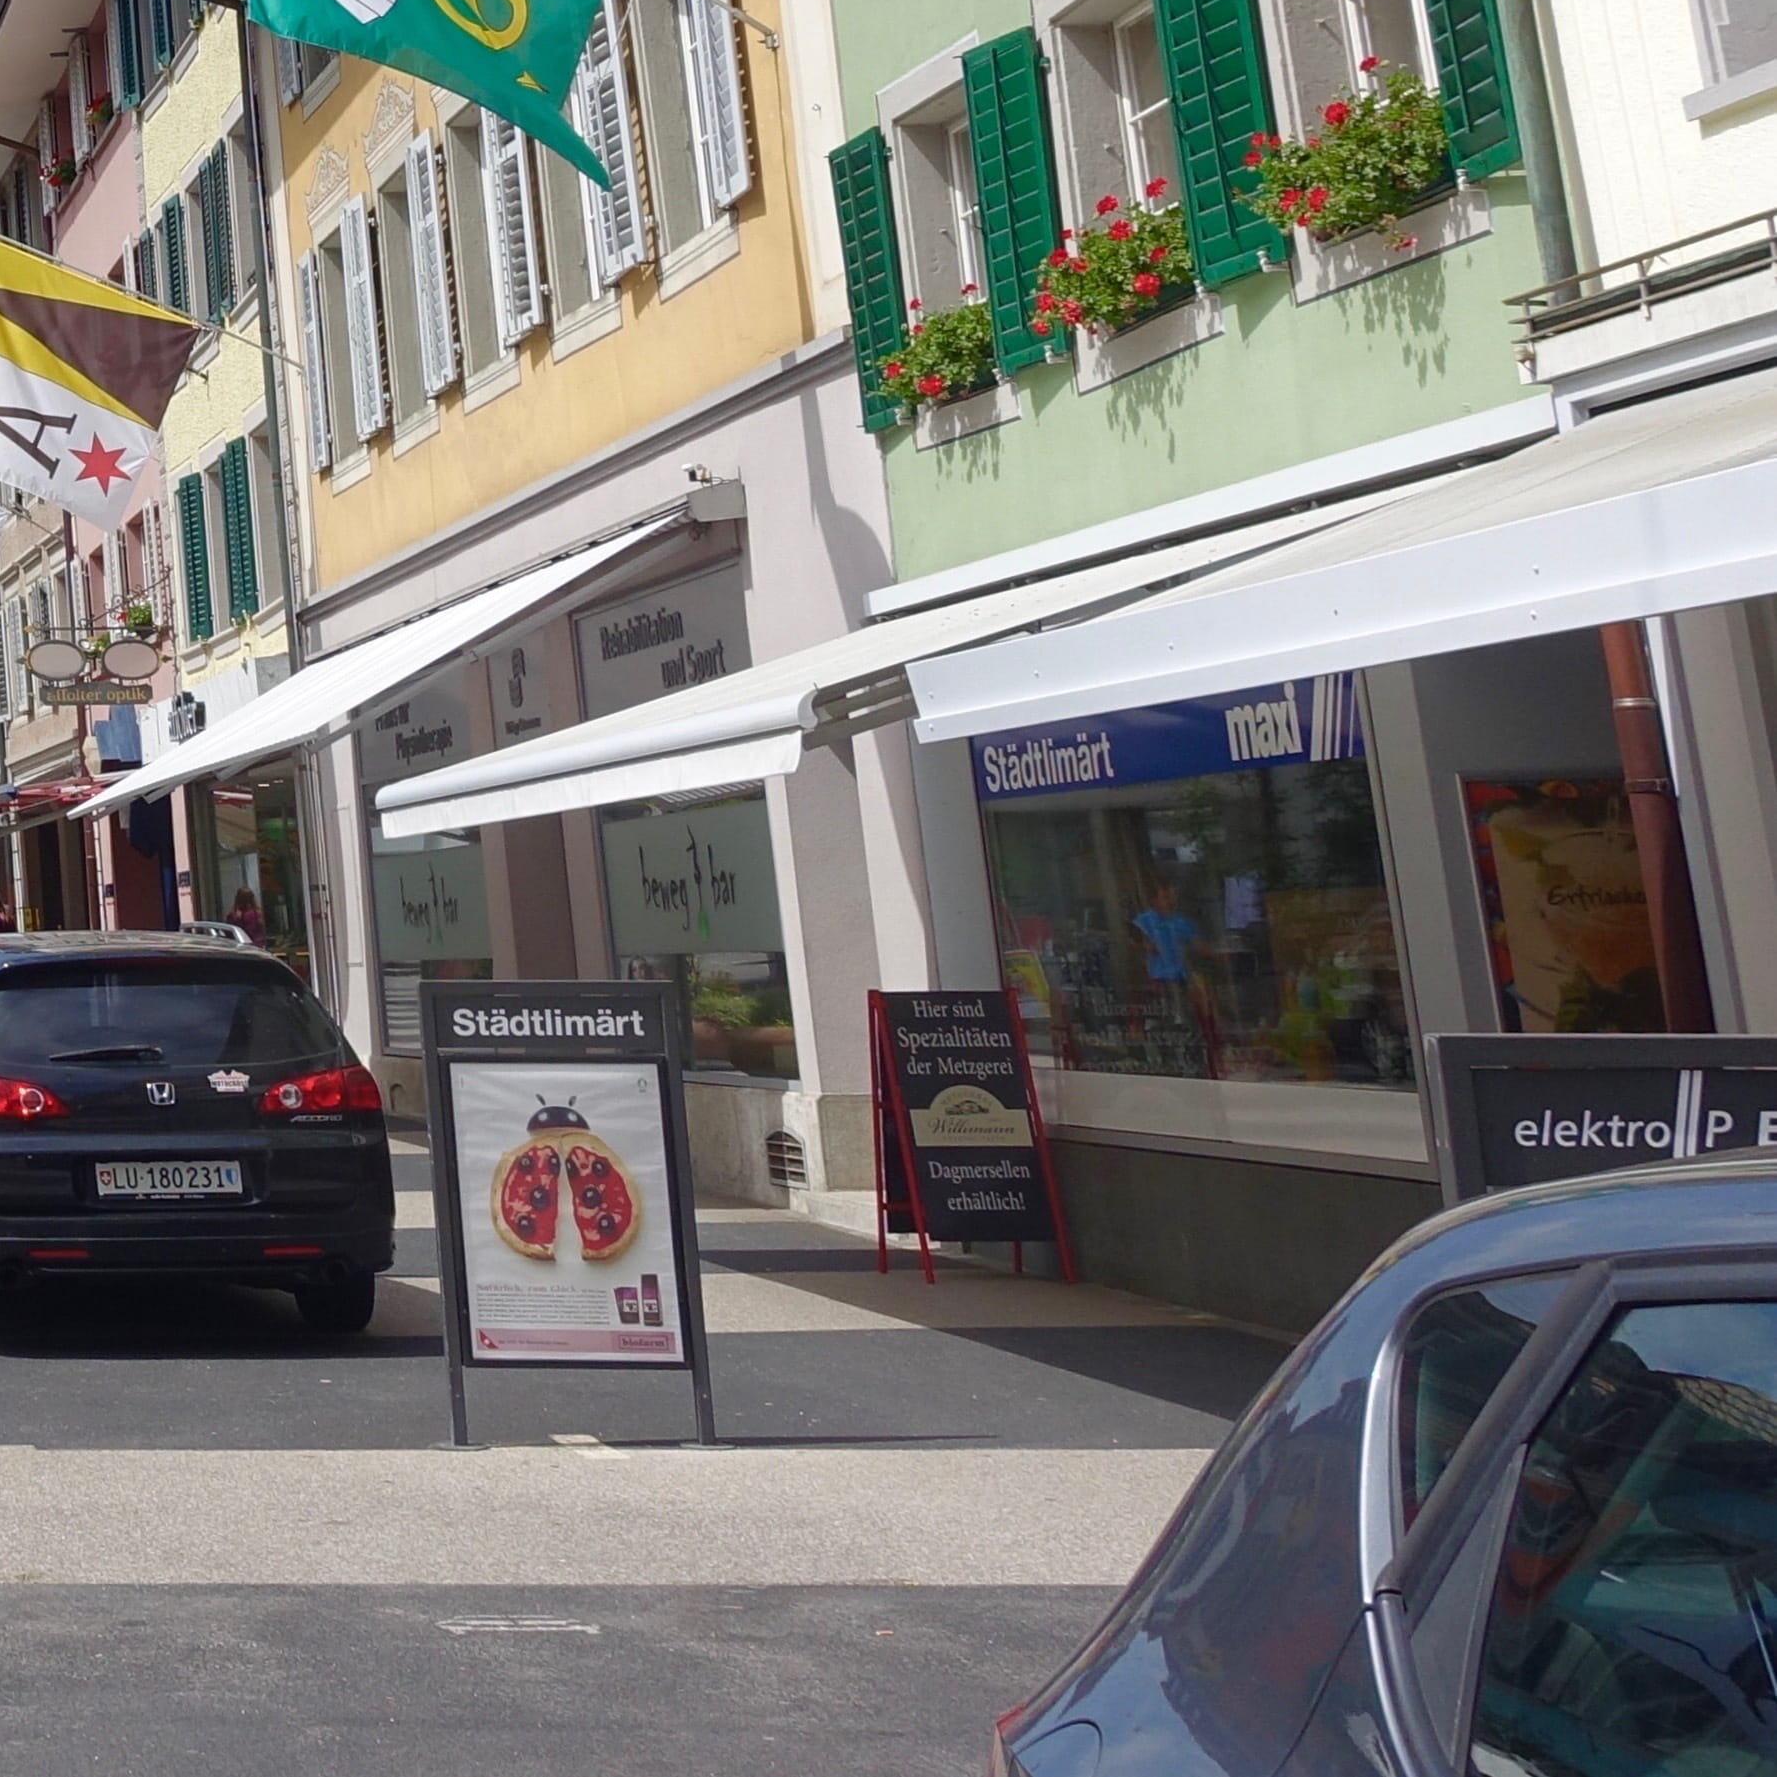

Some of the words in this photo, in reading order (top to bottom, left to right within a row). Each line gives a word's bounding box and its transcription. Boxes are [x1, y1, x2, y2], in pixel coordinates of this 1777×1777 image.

[599, 607, 684, 661] Rehabilitation
[660, 647, 687, 689] und
[686, 638, 727, 684] Sport
[47, 689, 103, 702] affolter
[106, 687, 147, 703] optik
[983, 732, 1114, 793] Städtlimärt
[1225, 681, 1303, 762] maxi
[638, 845, 690, 930] beweg
[707, 843, 736, 907] bar
[452, 1008, 645, 1037] Städtlimärt
[912, 1000, 947, 1018] Hier
[952, 999, 986, 1018] sind
[896, 1025, 1012, 1055] Spezialitäten
[906, 1056, 932, 1075] der
[937, 1056, 1014, 1081] Metzgerei
[290, 1114, 343, 1123] ACCORD
[1514, 1109, 1671, 1148] elektro
[1705, 1110, 1733, 1148] P
[928, 1160, 1031, 1185] Dagmersellen
[947, 1191, 1026, 1211] erhältlich!
